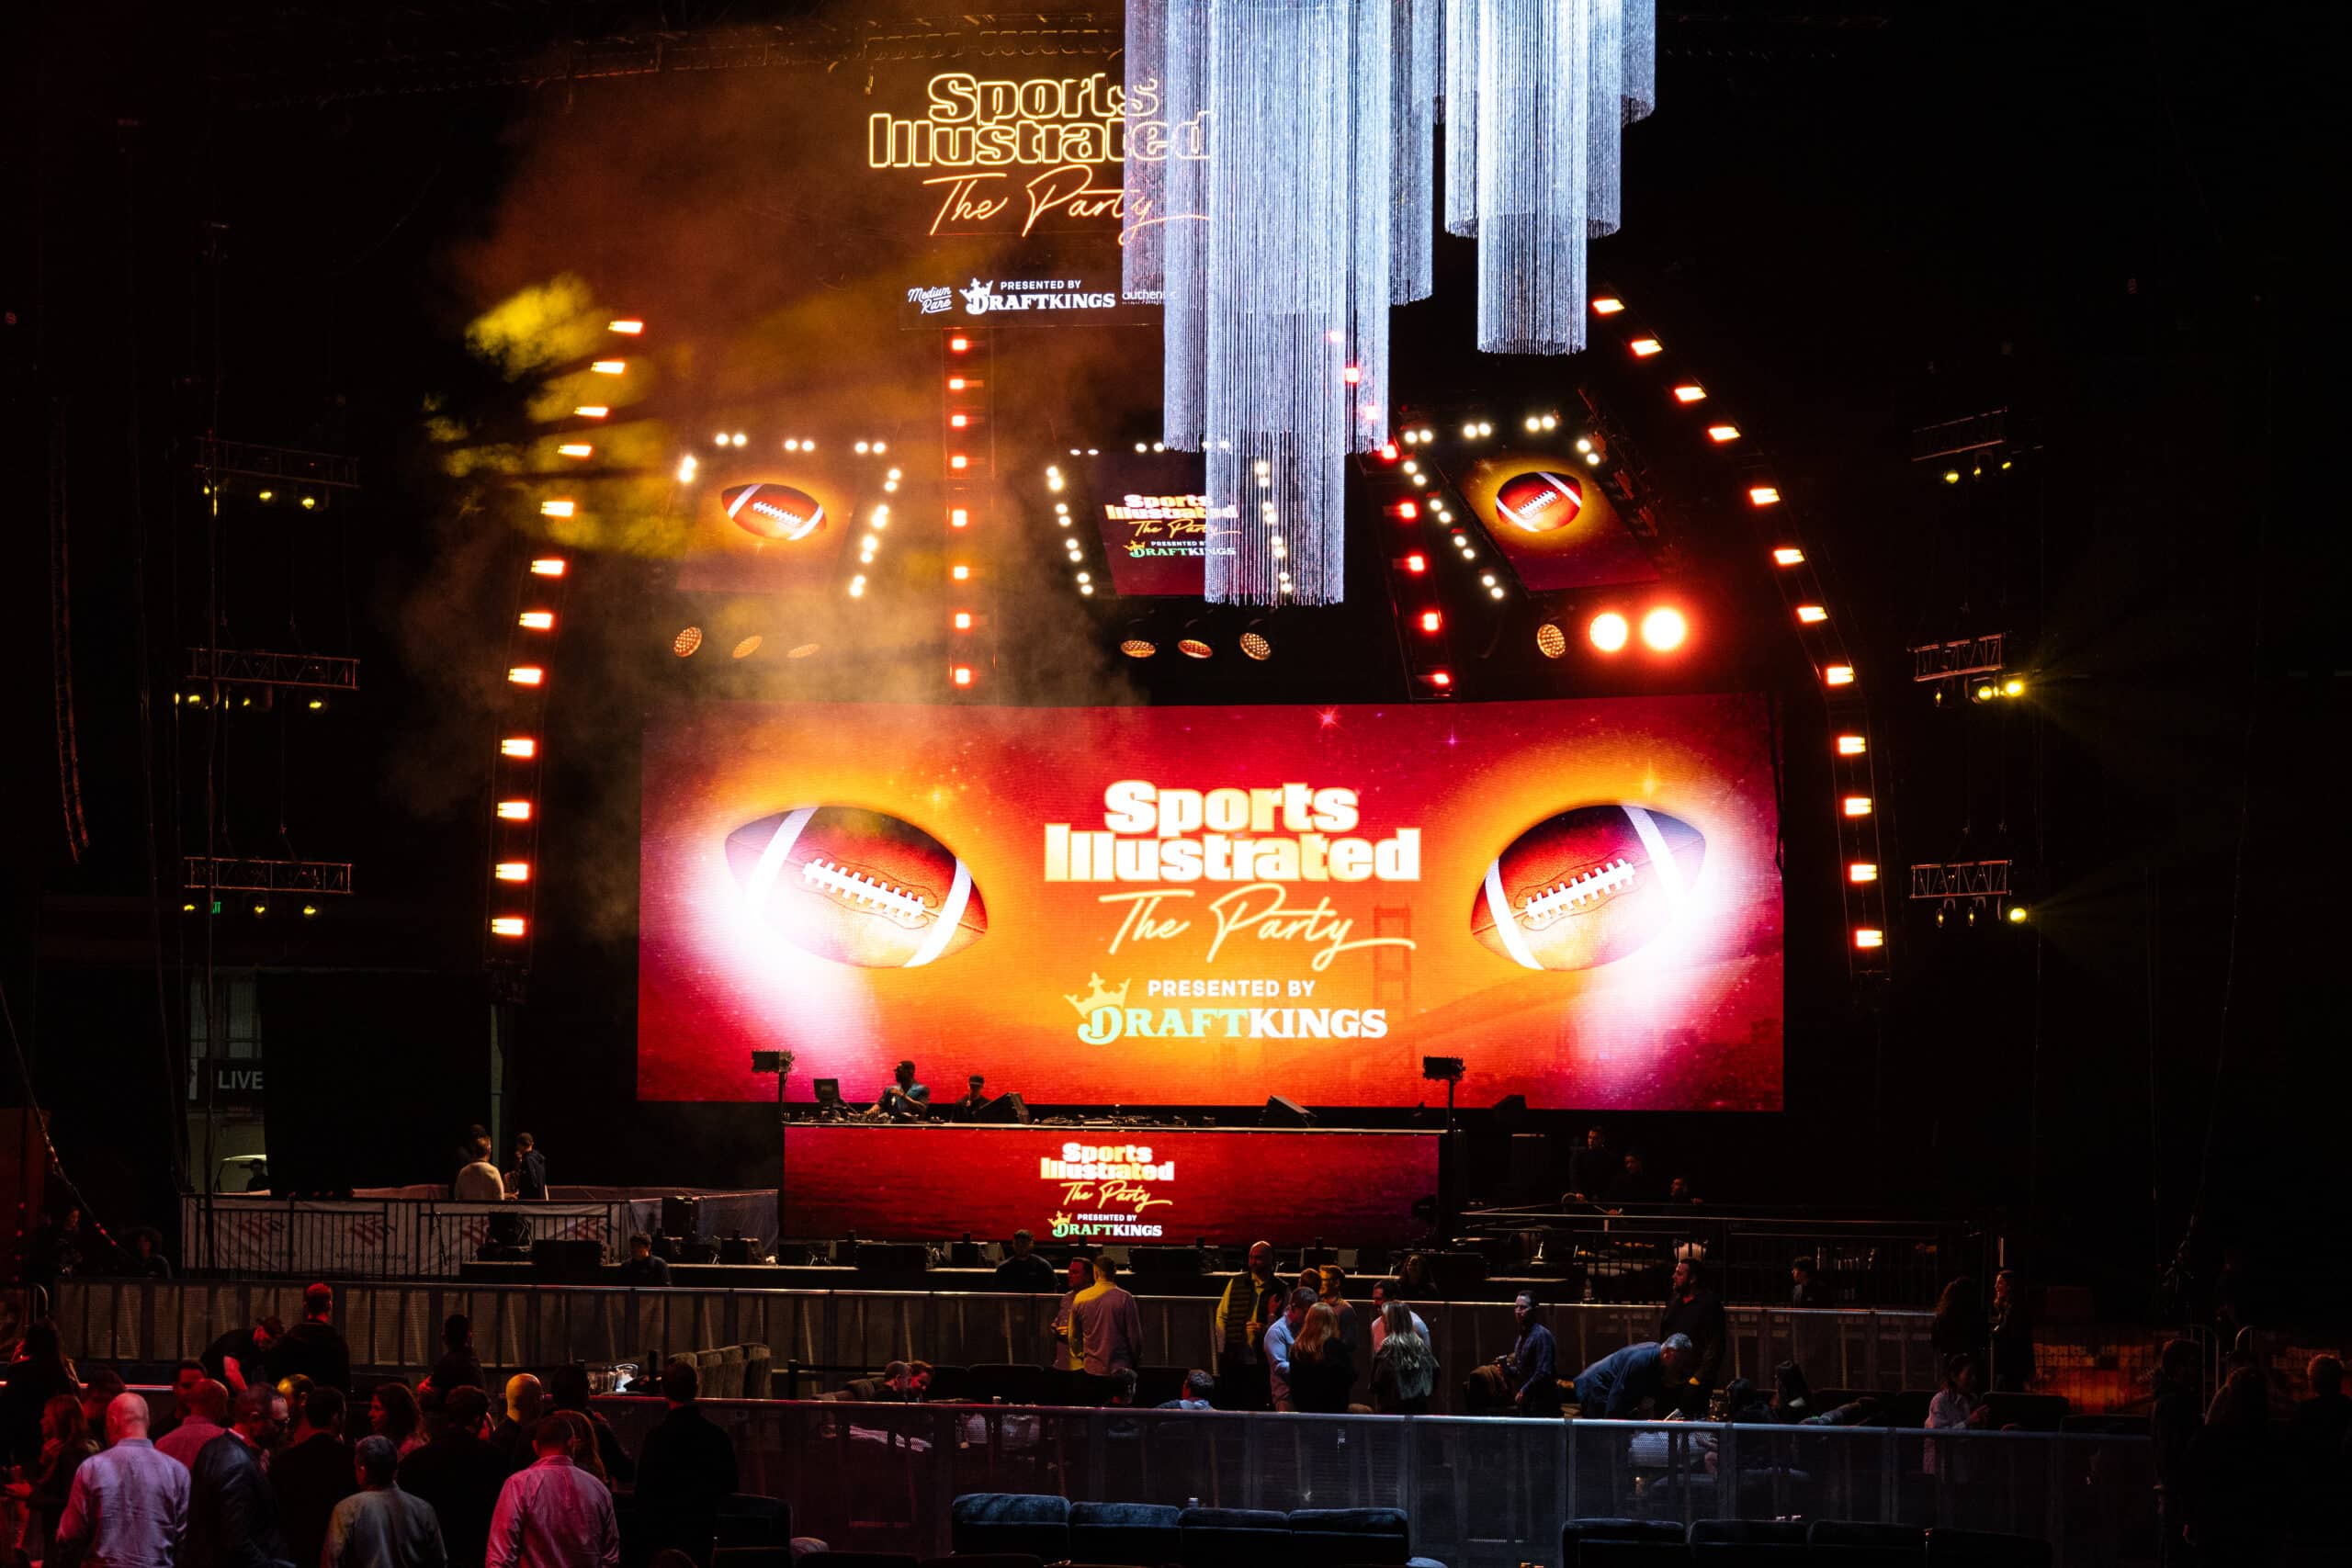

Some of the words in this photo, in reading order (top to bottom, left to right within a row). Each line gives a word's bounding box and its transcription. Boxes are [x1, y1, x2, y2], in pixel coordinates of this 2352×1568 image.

[928, 73, 1159, 125] Sports
[869, 110, 1216, 167] Illustrated
[922, 173, 1007, 235] The
[1023, 164, 1210, 245] Party
[908, 286, 951, 303] Medium
[1001, 280, 1064, 290] PRESENTED
[1067, 279, 1081, 289] BY
[922, 298, 952, 315] Rare
[966, 291, 1115, 315] DRAFTKINGS
[1124, 494, 1213, 508] Sports
[1128, 520, 1162, 536] The
[1104, 780, 1359, 838] Sports
[1045, 823, 1421, 882] Illustrated
[1099, 888, 1194, 954] The
[1207, 883, 1417, 971] Party
[1148, 979, 1279, 998] PRESENTED
[1288, 979, 1316, 998] BY
[1078, 1005, 1388, 1044] DRAFTKINGS
[218, 1069, 265, 1090] LIVE
[1062, 1143, 1152, 1163] Sports
[1040, 1157, 1174, 1181] Illustrated
[1059, 1181, 1095, 1206] The
[1098, 1179, 1173, 1213] Party
[1077, 1213, 1125, 1222] PRESENTED
[1126, 1213, 1137, 1222] BY
[1052, 1223, 1162, 1237] DRAFTKINGS
